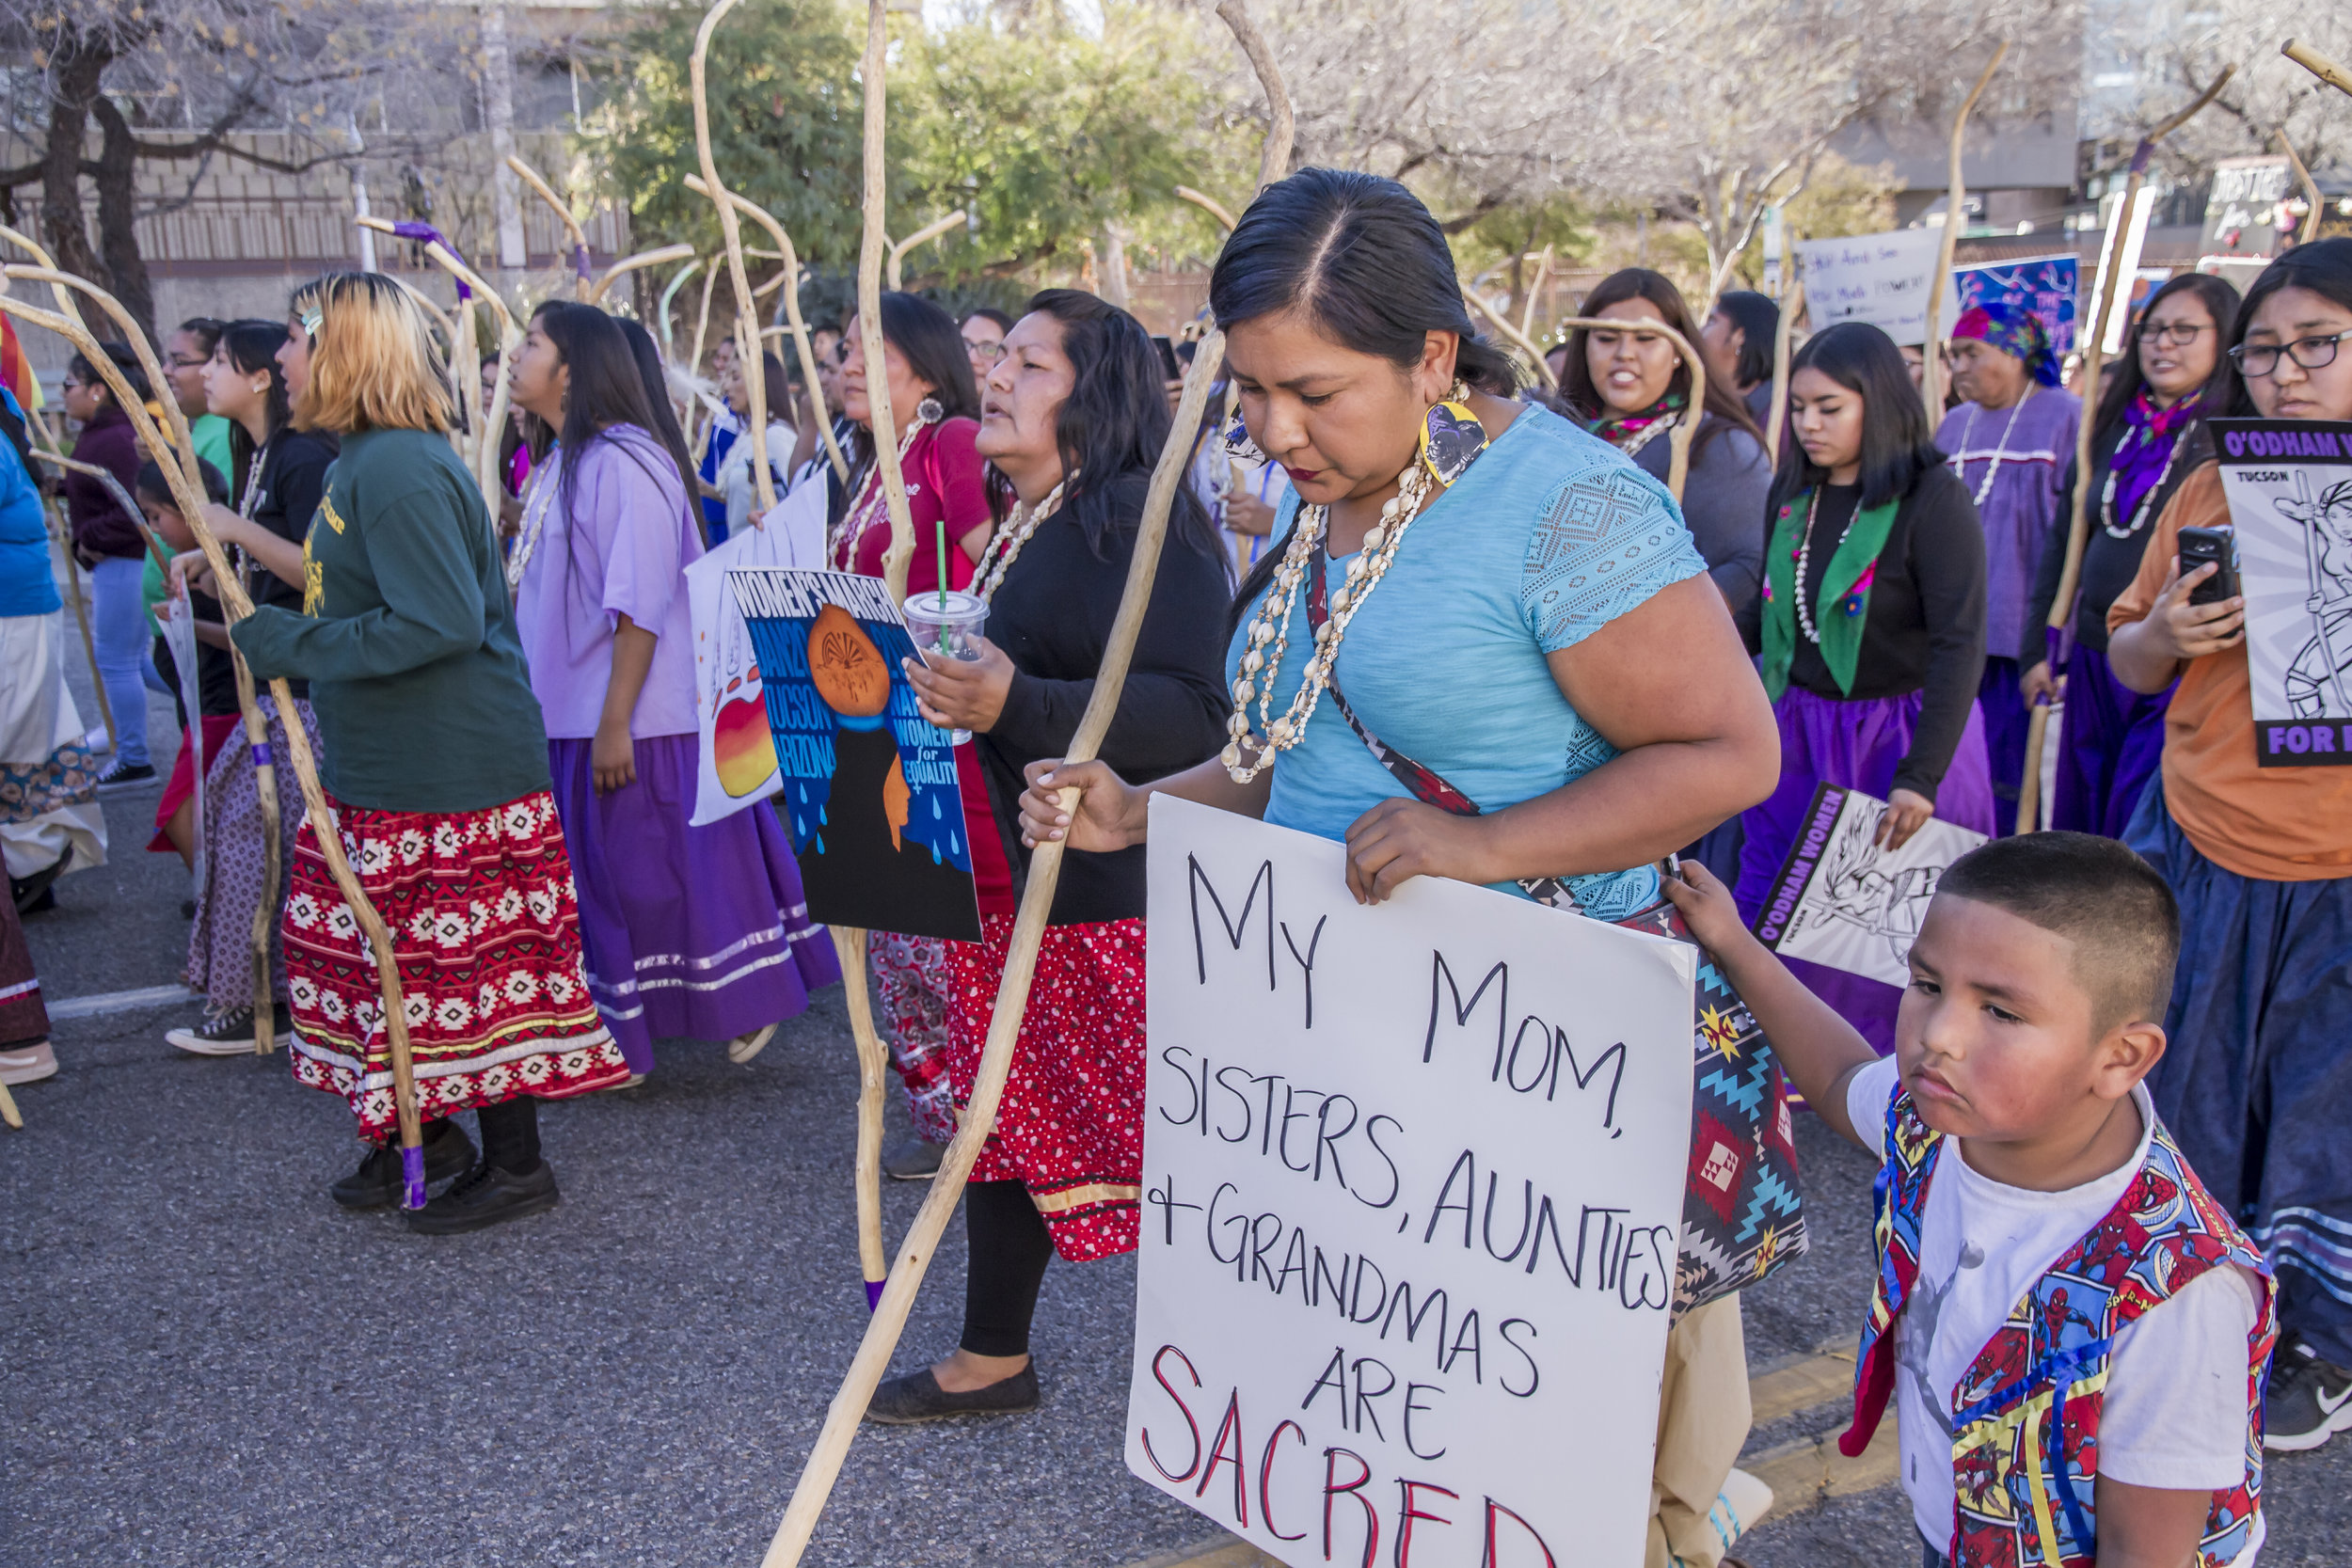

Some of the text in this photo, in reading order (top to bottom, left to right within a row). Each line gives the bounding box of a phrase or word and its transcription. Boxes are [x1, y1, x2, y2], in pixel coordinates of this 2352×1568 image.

[2224, 430, 2342, 457] O'ODHAM
[2236, 471, 2289, 482] TUCSON
[726, 572, 904, 626] WOMEN'S MARCH
[763, 684, 833, 730] TUCSON
[894, 719, 953, 747] WOMEN
[2267, 725, 2337, 754] FOR
[772, 734, 837, 780] ARIZONA
[916, 744, 939, 764] for
[904, 761, 959, 790] EQUALITY
[1759, 789, 1844, 941] O'ODHAM WOMEN
[1786, 910, 1808, 943] TUCSON
[1159, 1046, 1674, 1310] SISTERS, AUNTIES
[1207, 1181, 1540, 1398] GRANDMAS
[1302, 1347, 1447, 1461] ARE
